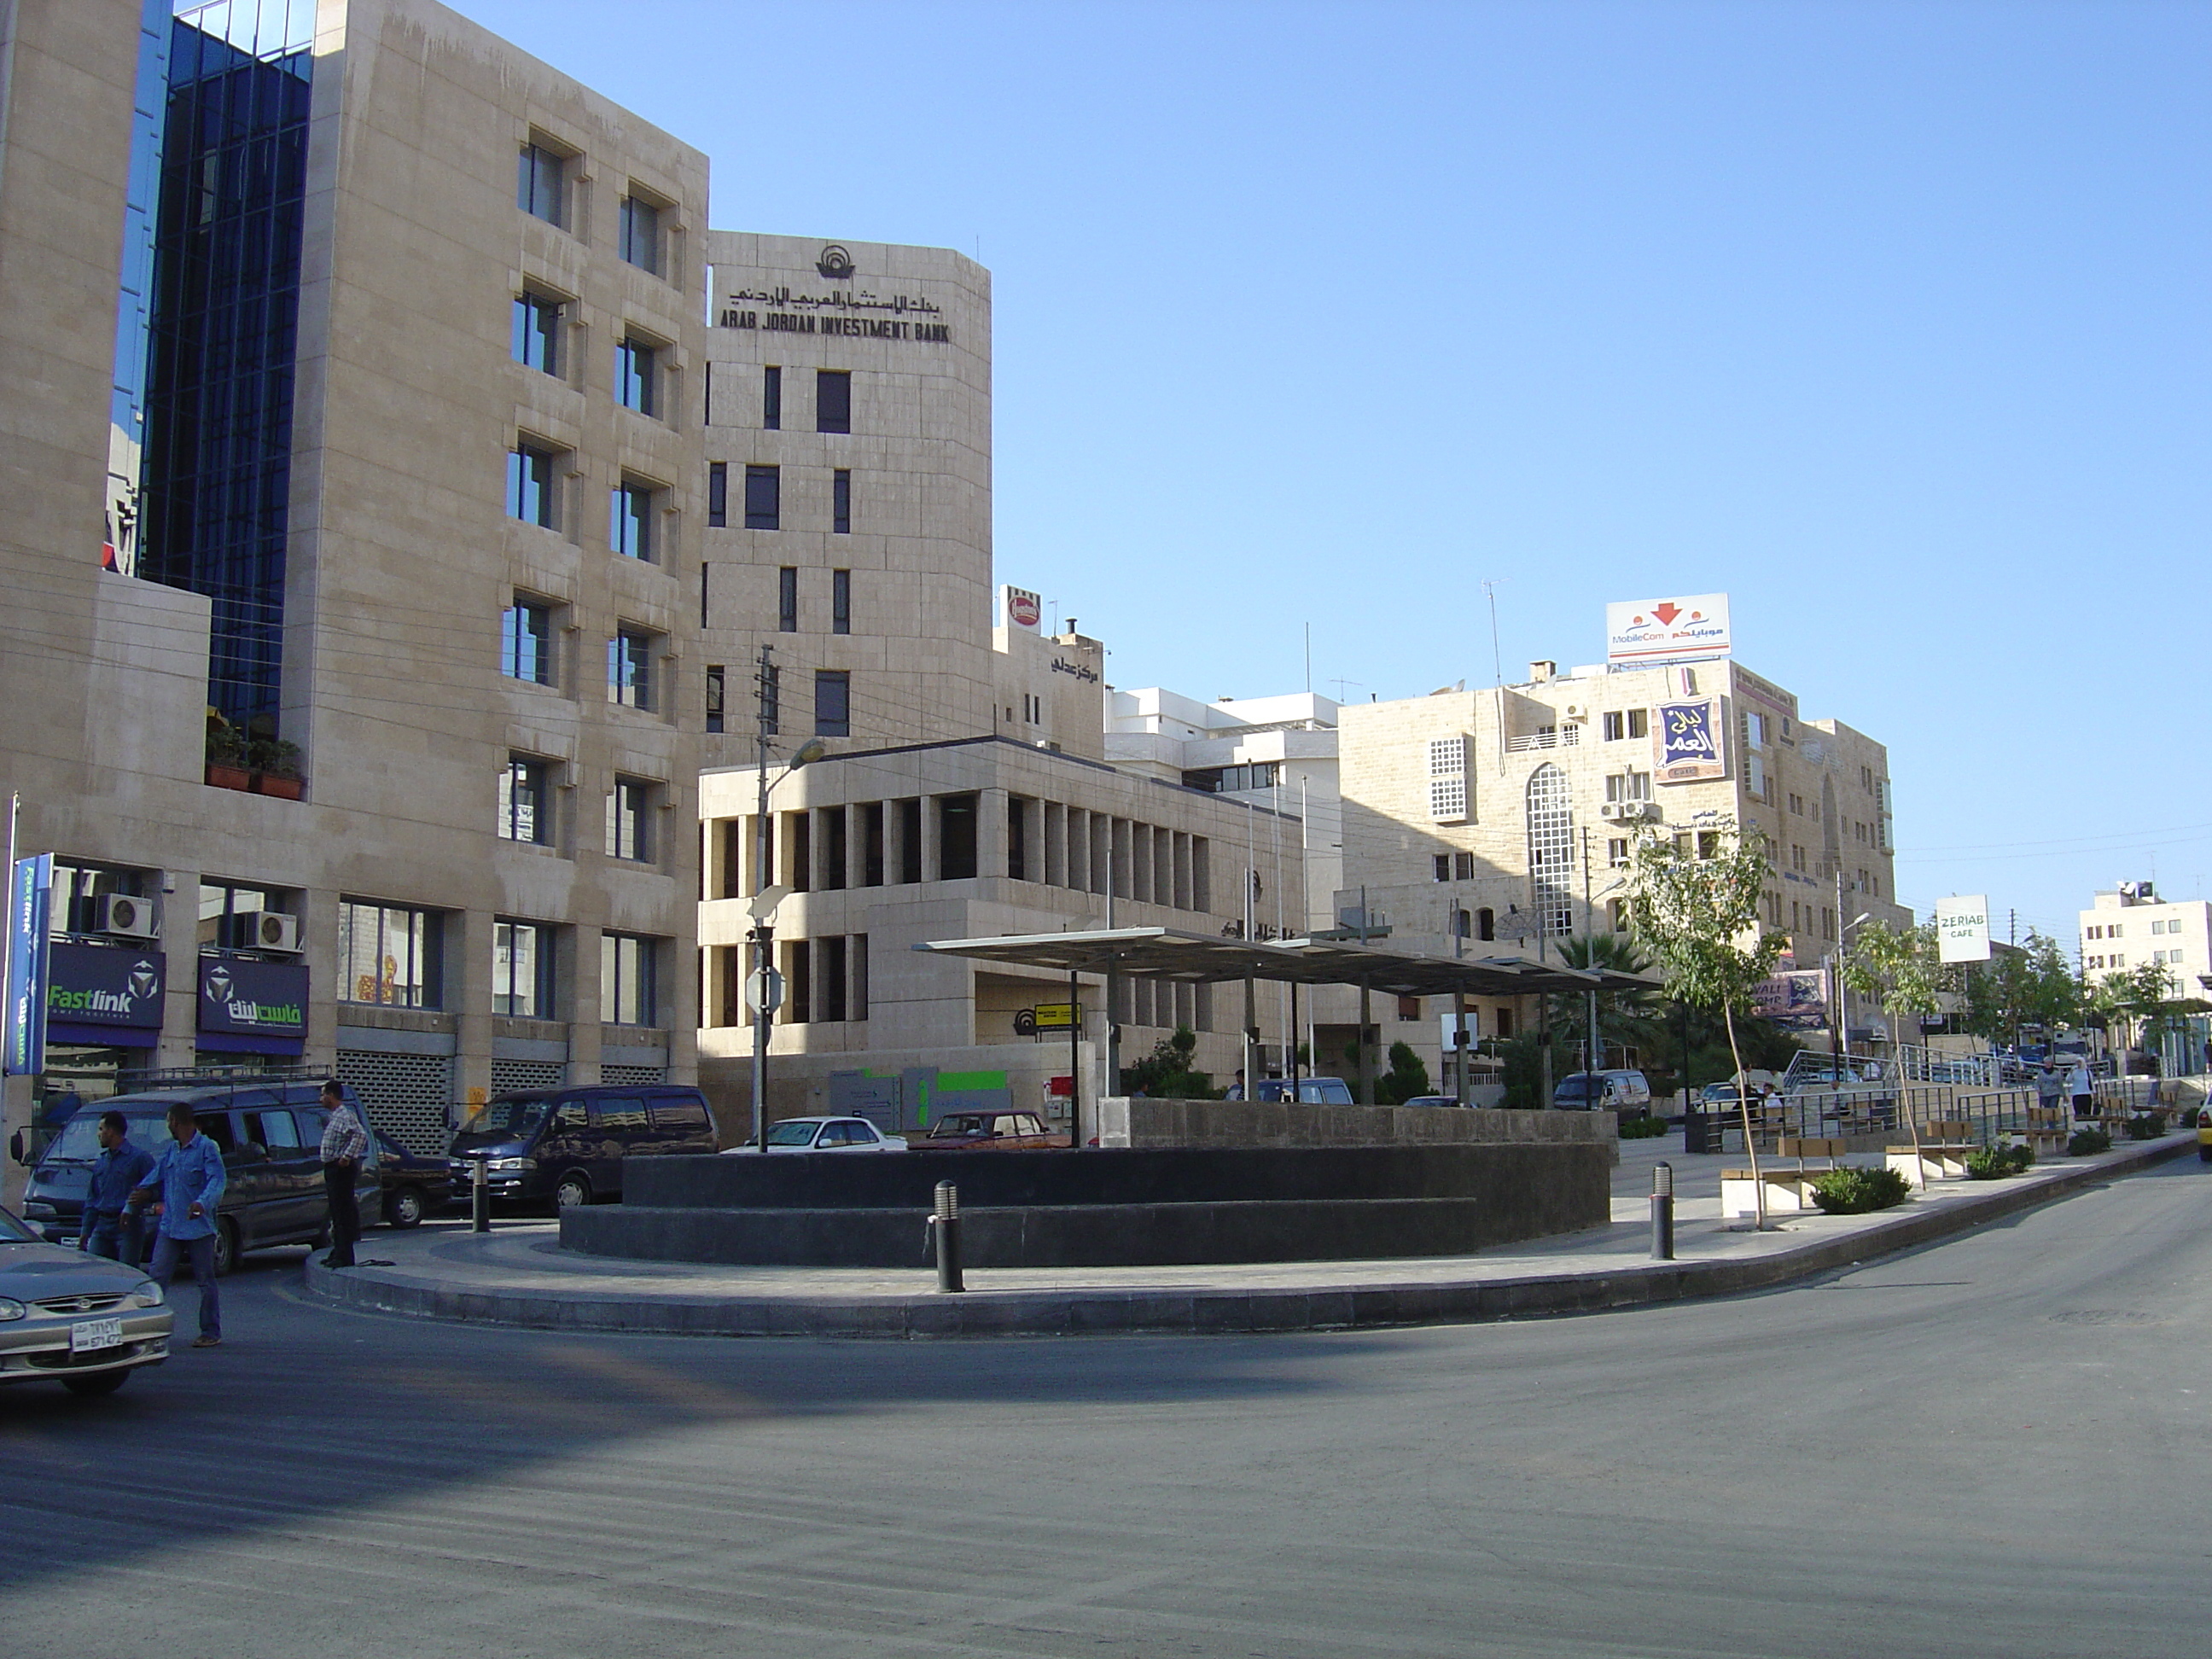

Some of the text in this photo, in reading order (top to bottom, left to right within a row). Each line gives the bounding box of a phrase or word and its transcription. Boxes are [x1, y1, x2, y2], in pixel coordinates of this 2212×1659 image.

[790, 290, 840, 310] العربي
[909, 296, 940, 318] بنك
[720, 309, 950, 341] ARAB JORDAN INVESTMENT BANK
[1612, 632, 1664, 644] MobileCom
[1671, 708, 1703, 734] ليالي
[22, 865, 34, 934] Fastlink
[1941, 915, 1984, 928] ZERIAB
[1950, 929, 1973, 938] CAFE
[48, 985, 132, 1013] Fastlink
